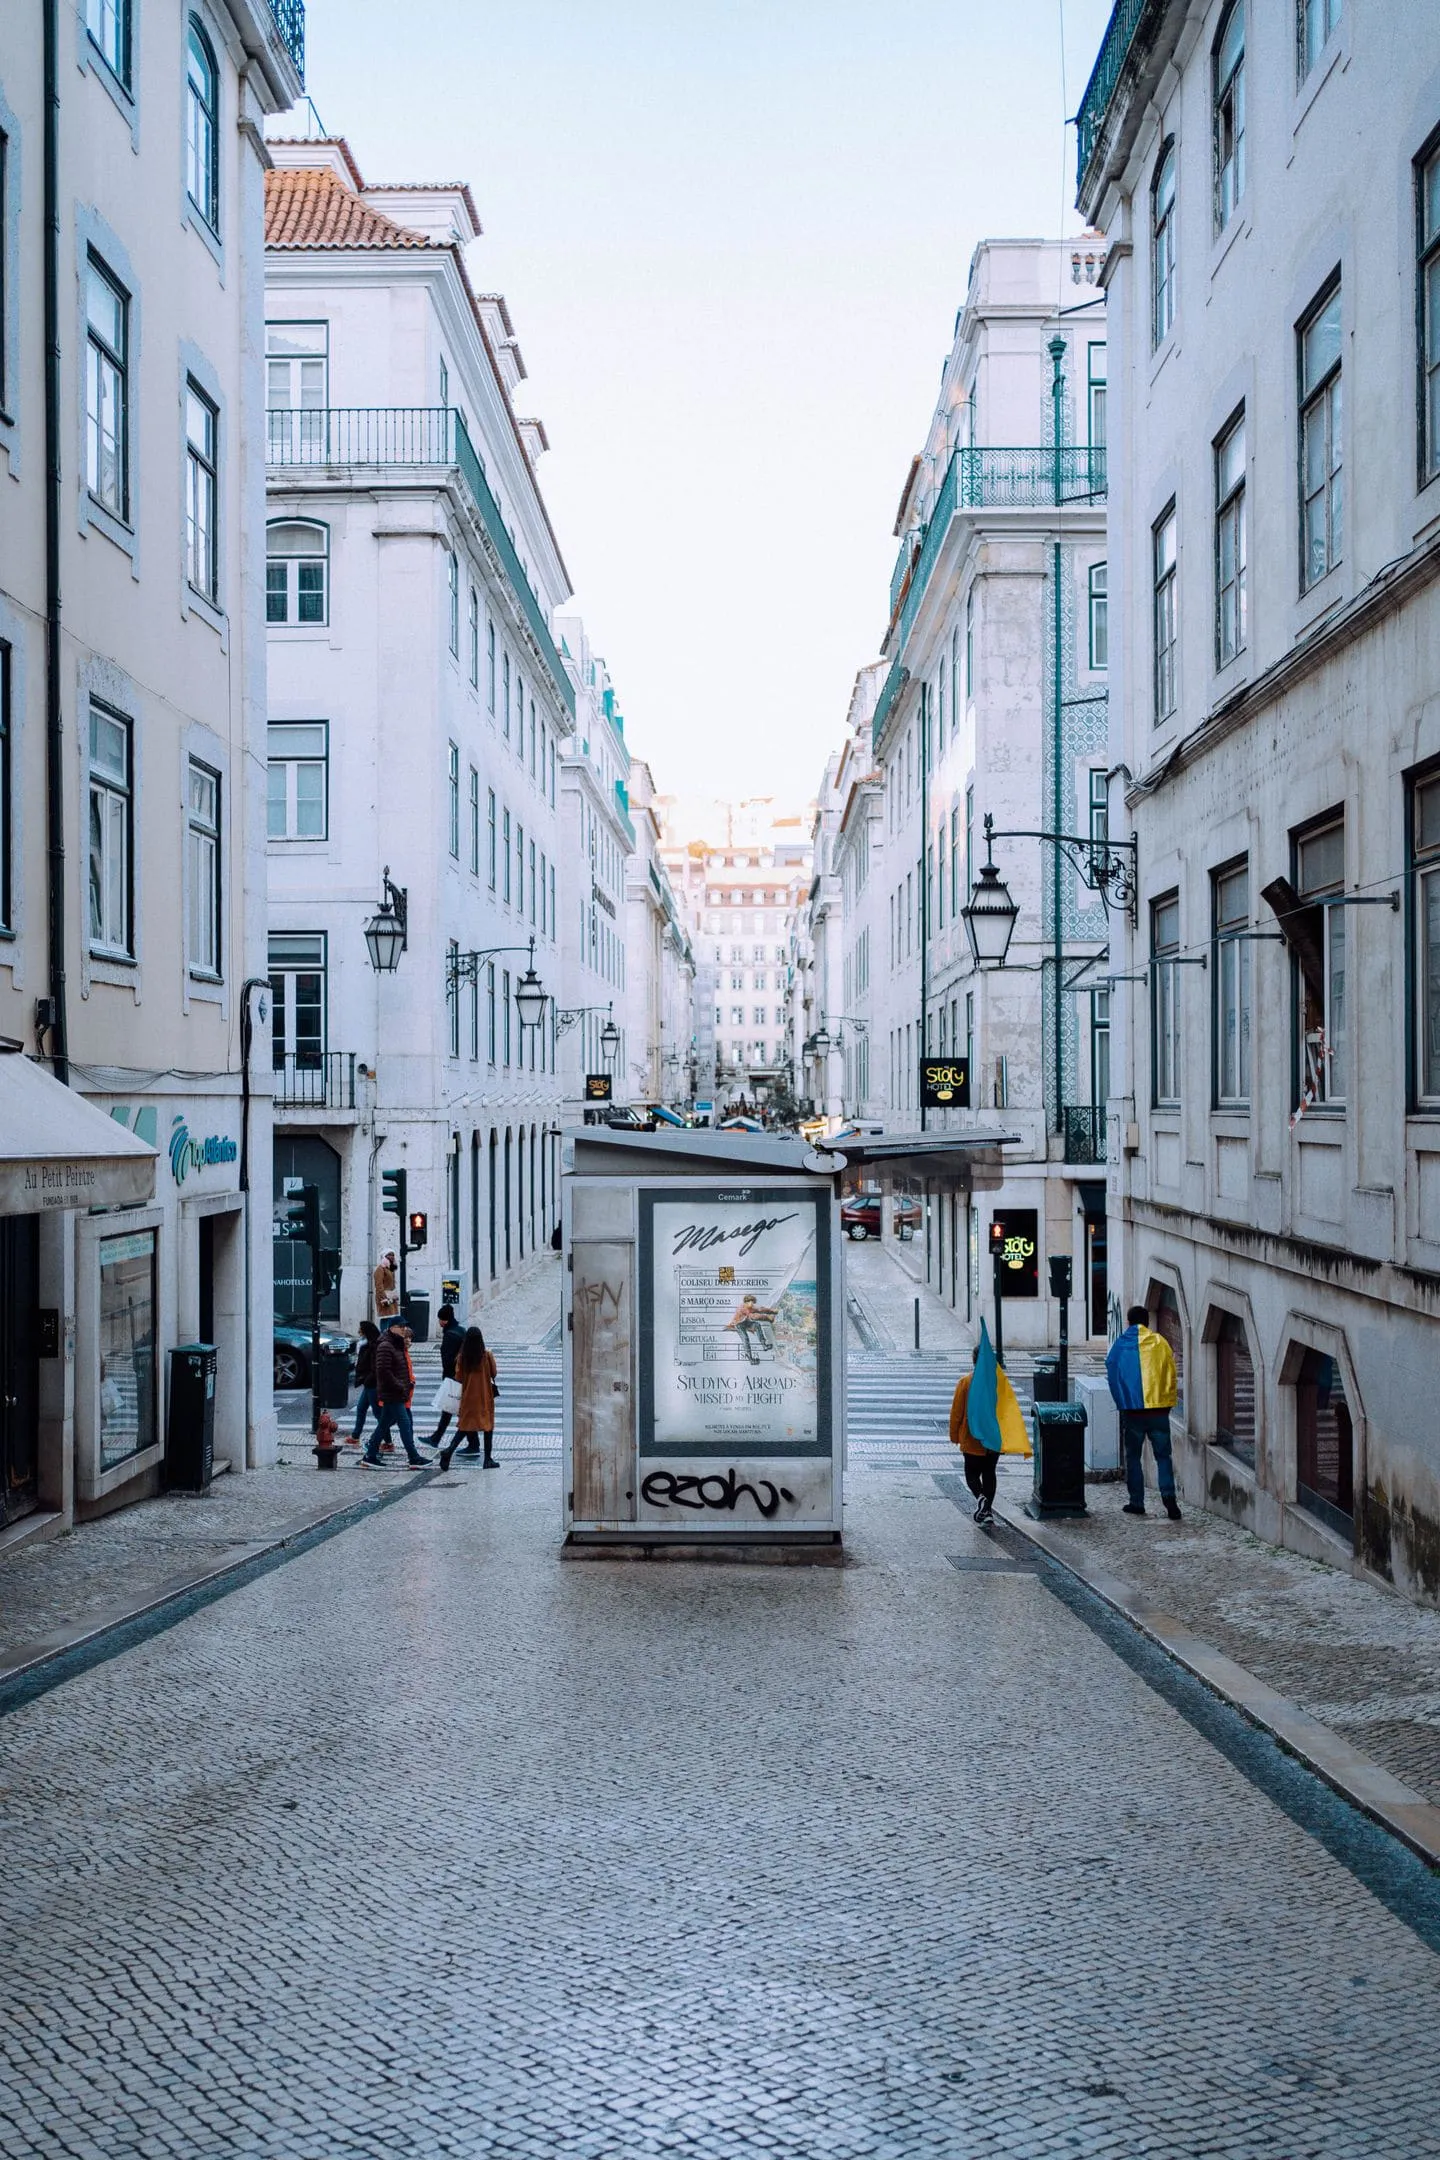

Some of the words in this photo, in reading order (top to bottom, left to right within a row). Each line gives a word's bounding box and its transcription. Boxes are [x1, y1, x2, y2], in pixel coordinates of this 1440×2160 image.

[926, 1083, 954, 1091] HOTEL
[24, 1167, 38, 1189] Au
[41, 1166, 64, 1188] Petit
[65, 1165, 96, 1187] Peintre
[718, 1193, 748, 1201] Cemark
[672, 1212, 800, 1257] Masego
[731, 1279, 769, 1287] RECREIOS
[688, 1297, 715, 1306] MARÇO
[681, 1316, 706, 1324] LISBOA
[681, 1335, 718, 1343] PORTUGAL
[676, 1375, 738, 1391] STUDYING
[742, 1375, 797, 1391] ABROAD:
[694, 1393, 733, 1405] MISSED
[747, 1393, 784, 1405] FLIGHT
